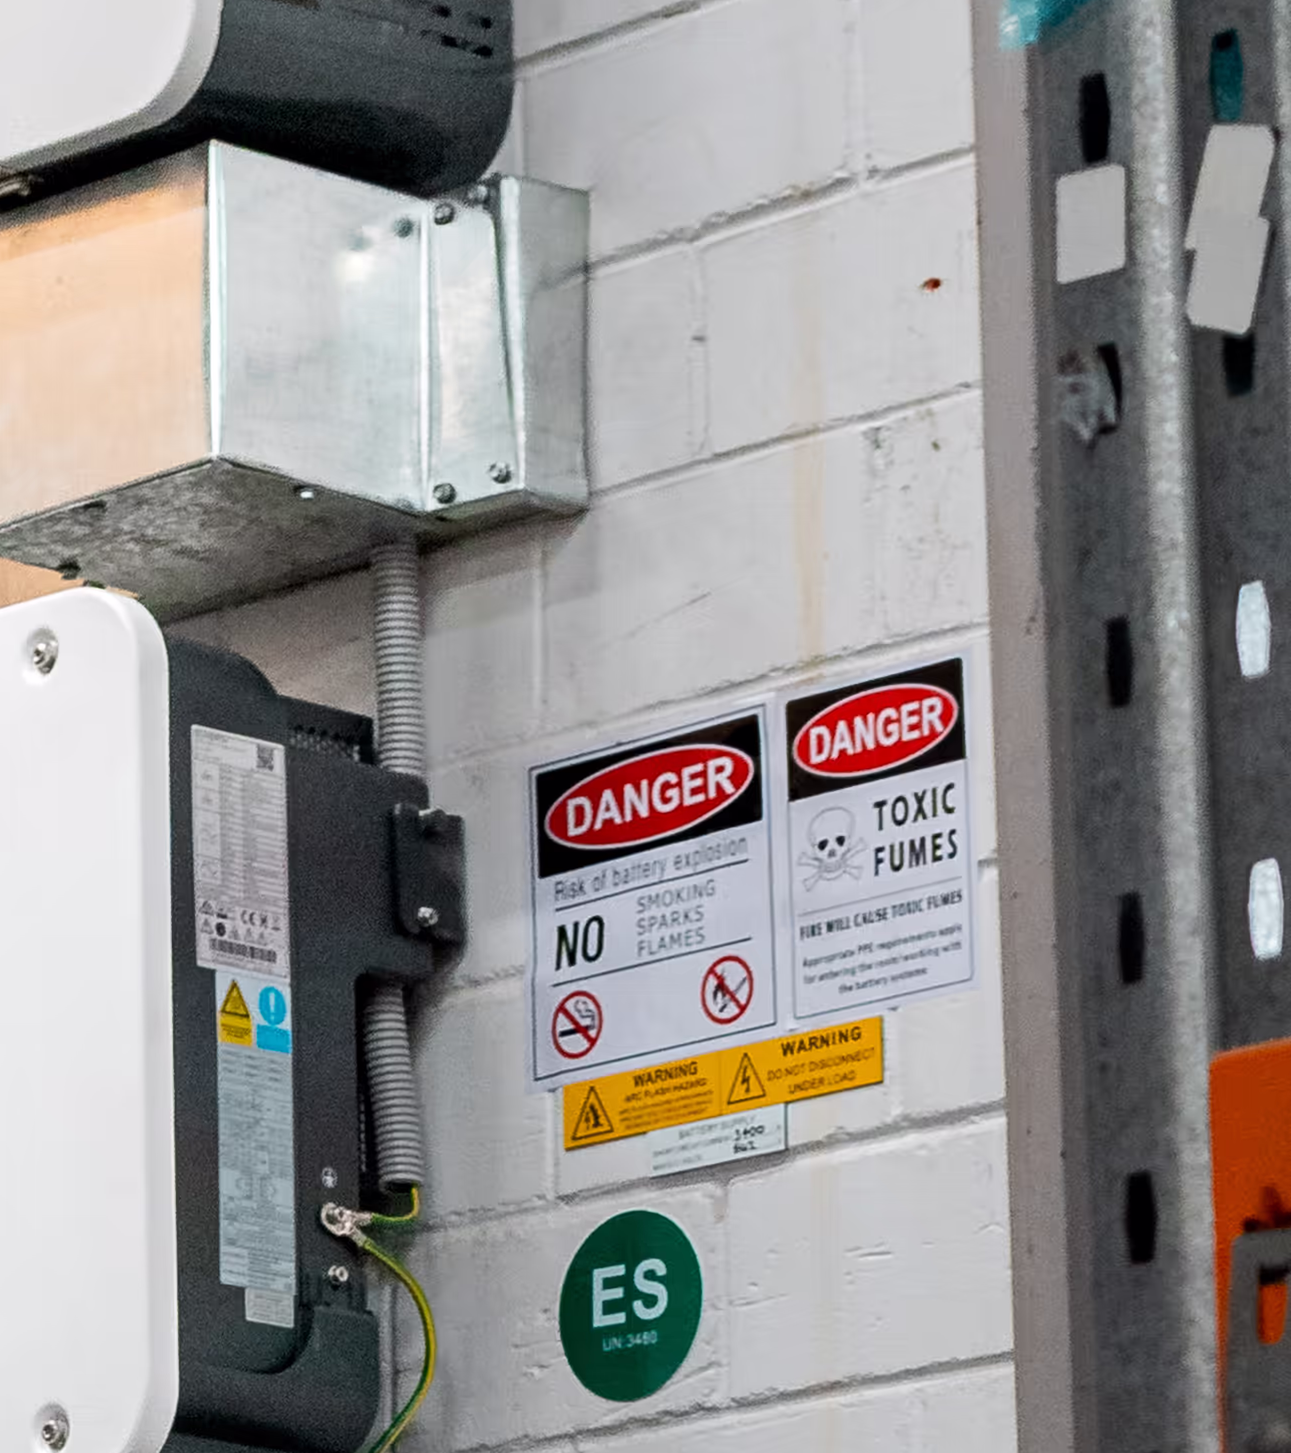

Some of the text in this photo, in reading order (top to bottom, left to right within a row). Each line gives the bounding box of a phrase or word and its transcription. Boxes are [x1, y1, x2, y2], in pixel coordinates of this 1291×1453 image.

[809, 697, 944, 765] DANGER
[567, 756, 737, 837] DANGER
[873, 782, 956, 831] TOXIC
[554, 837, 748, 902] Risk of battery explosion
[874, 828, 958, 877] FUMES
[636, 879, 716, 914] SMOKING
[854, 907, 888, 927] CAUSE
[927, 889, 963, 910] FUMES
[555, 905, 705, 972] NO SPARKS
[637, 926, 705, 957] FLAMES
[781, 1025, 862, 1057] WARNING
[633, 1061, 698, 1088] WARNING
[592, 1258, 668, 1328] ES
